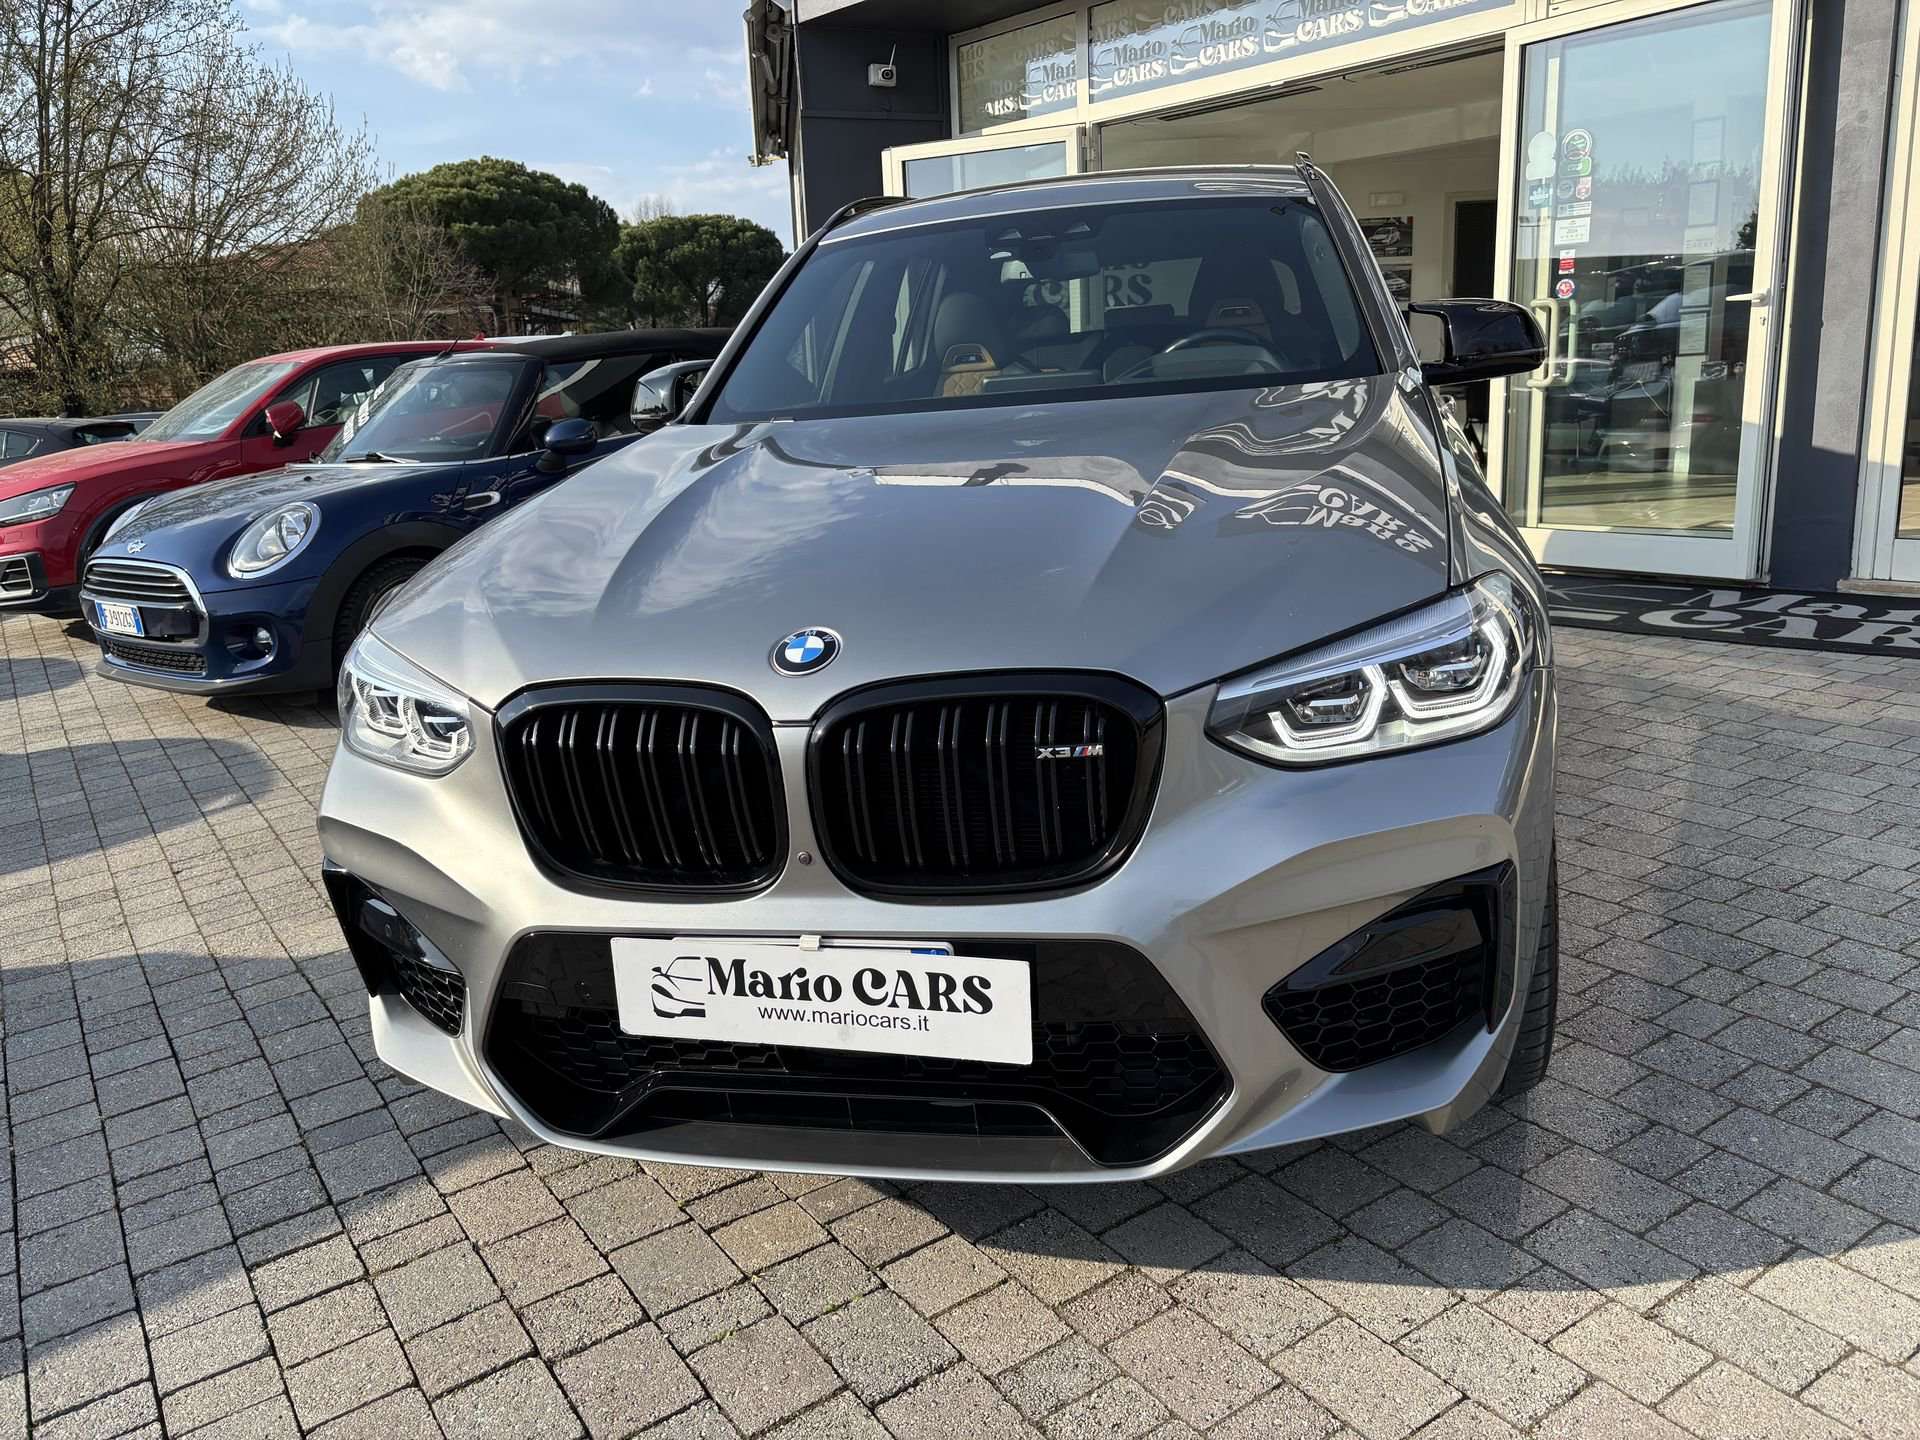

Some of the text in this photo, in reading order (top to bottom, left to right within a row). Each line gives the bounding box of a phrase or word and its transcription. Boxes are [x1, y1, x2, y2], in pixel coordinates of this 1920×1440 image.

[1200, 16, 1258, 44] Mario
[1296, 9, 1364, 42] CARS
[1113, 40, 1166, 67] Mario
[1199, 36, 1259, 67] CARS
[1113, 59, 1168, 87] CARS
[704, 956, 993, 1015] Mario CARS
[758, 1005, 930, 1033] www.mariocars.it
